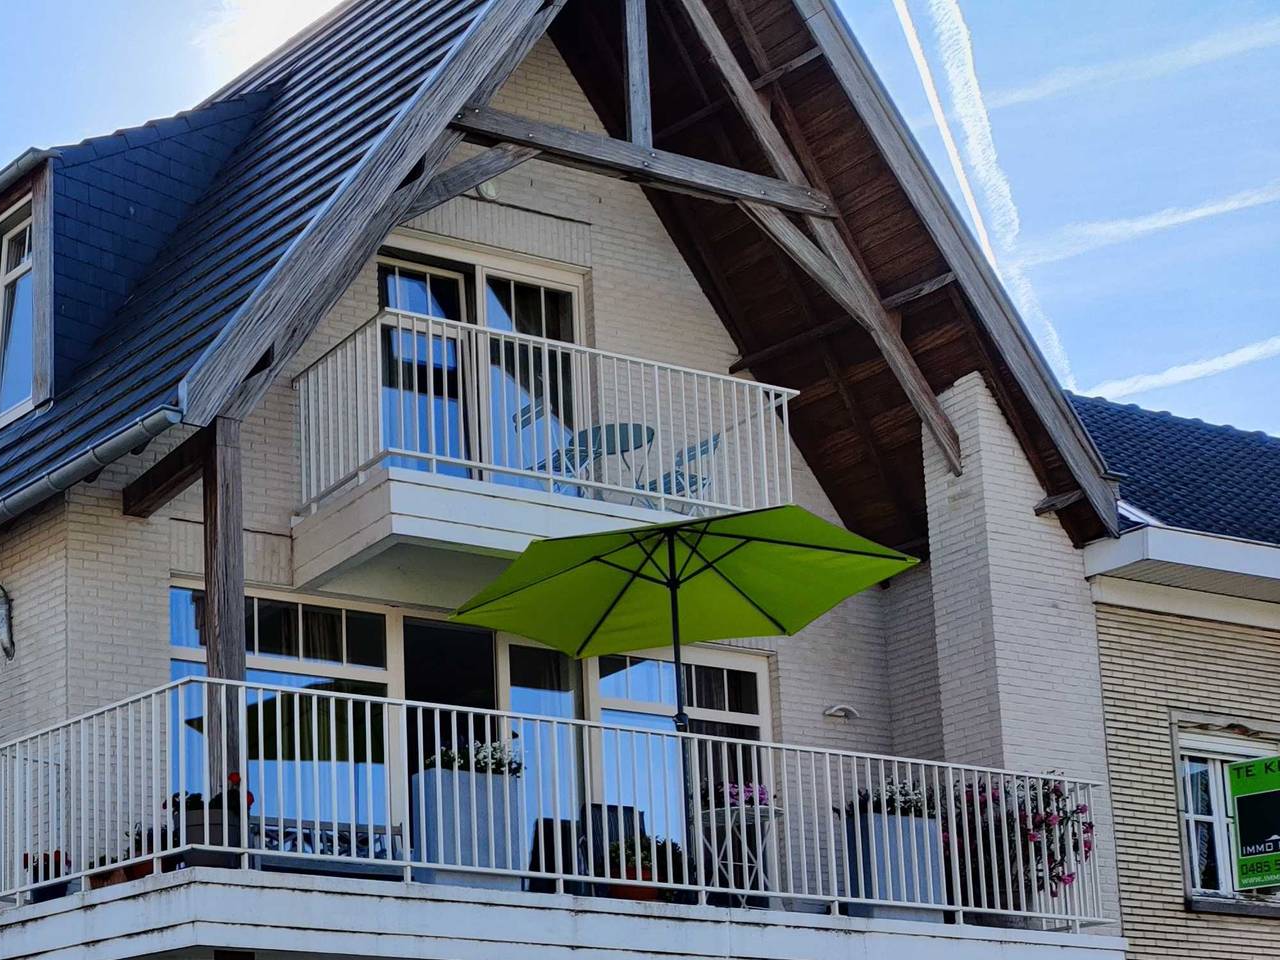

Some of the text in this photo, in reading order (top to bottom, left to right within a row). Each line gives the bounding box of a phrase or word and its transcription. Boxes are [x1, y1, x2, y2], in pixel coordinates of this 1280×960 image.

[1233, 759, 1280, 779] TE K
[1243, 843, 1274, 854] IMMO
